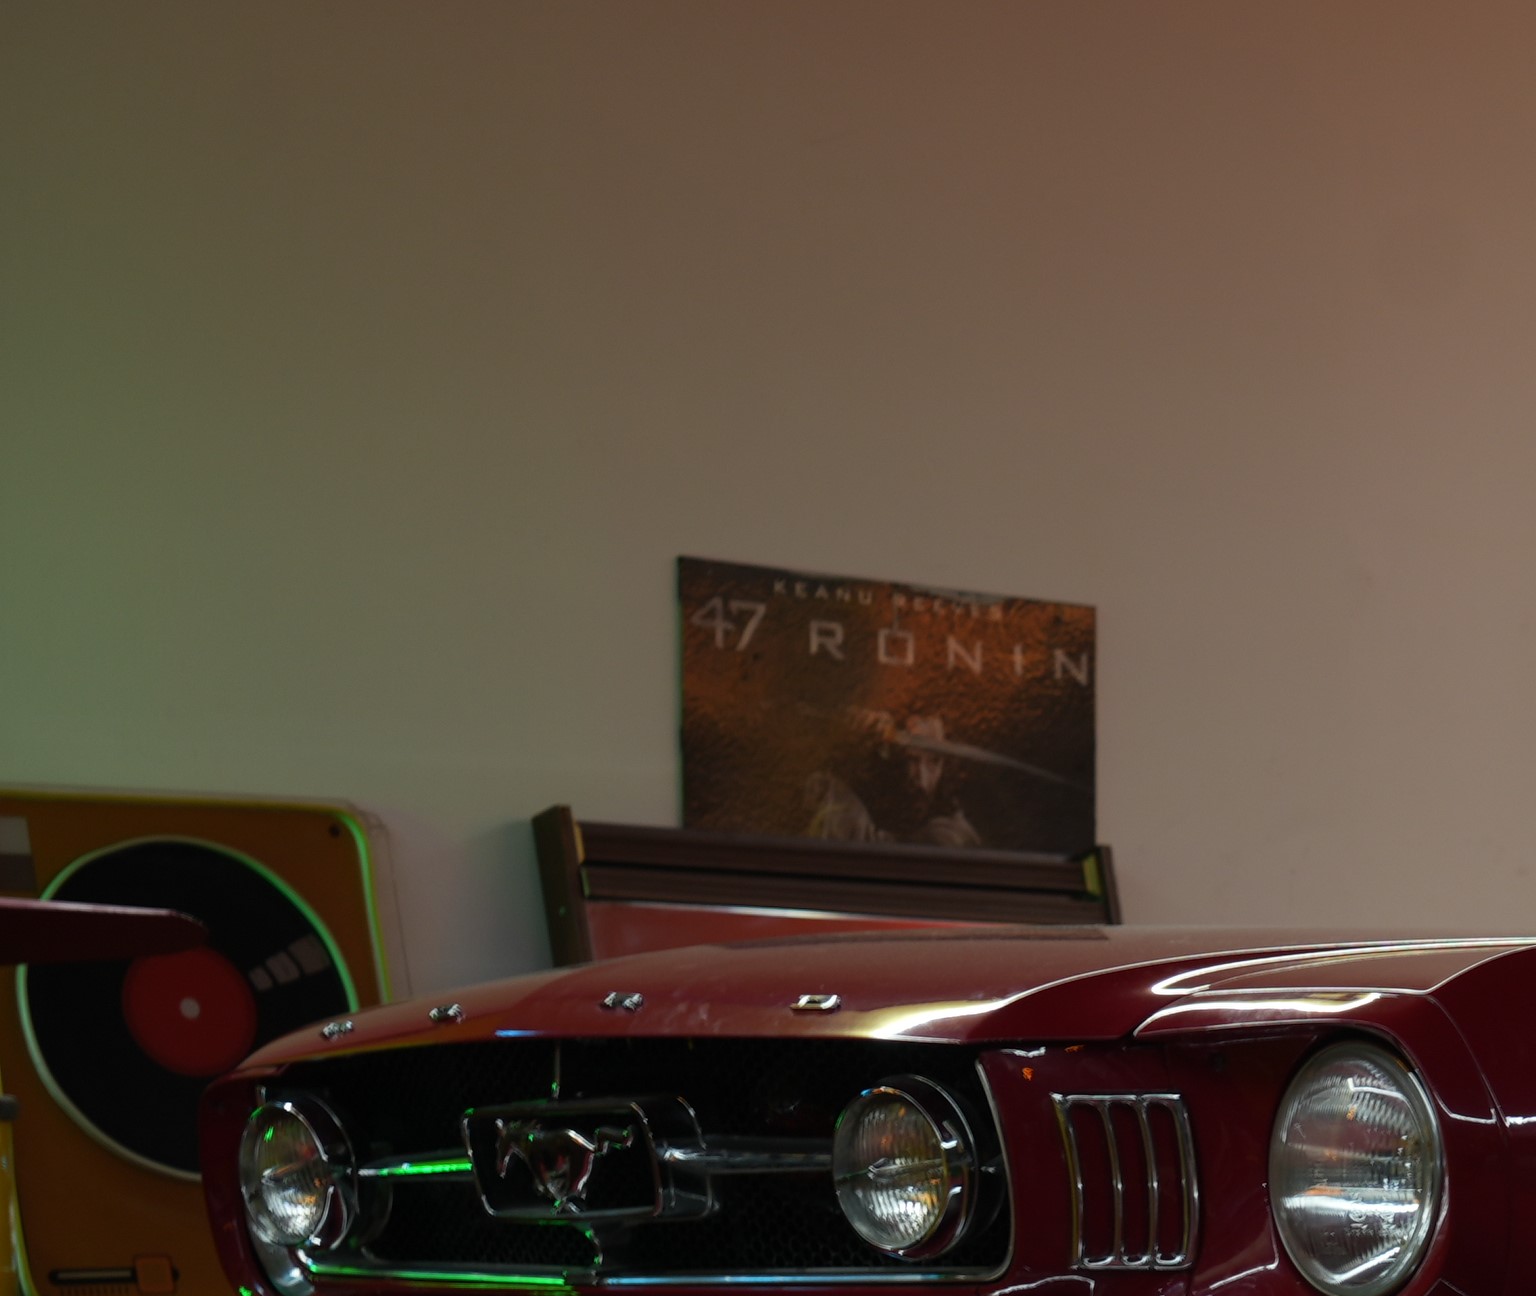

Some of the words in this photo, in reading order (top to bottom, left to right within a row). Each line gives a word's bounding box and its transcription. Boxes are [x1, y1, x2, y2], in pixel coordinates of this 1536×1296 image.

[773, 578, 873, 605] KEANU
[690, 596, 766, 652] 47
[808, 618, 1090, 687] RONIN
